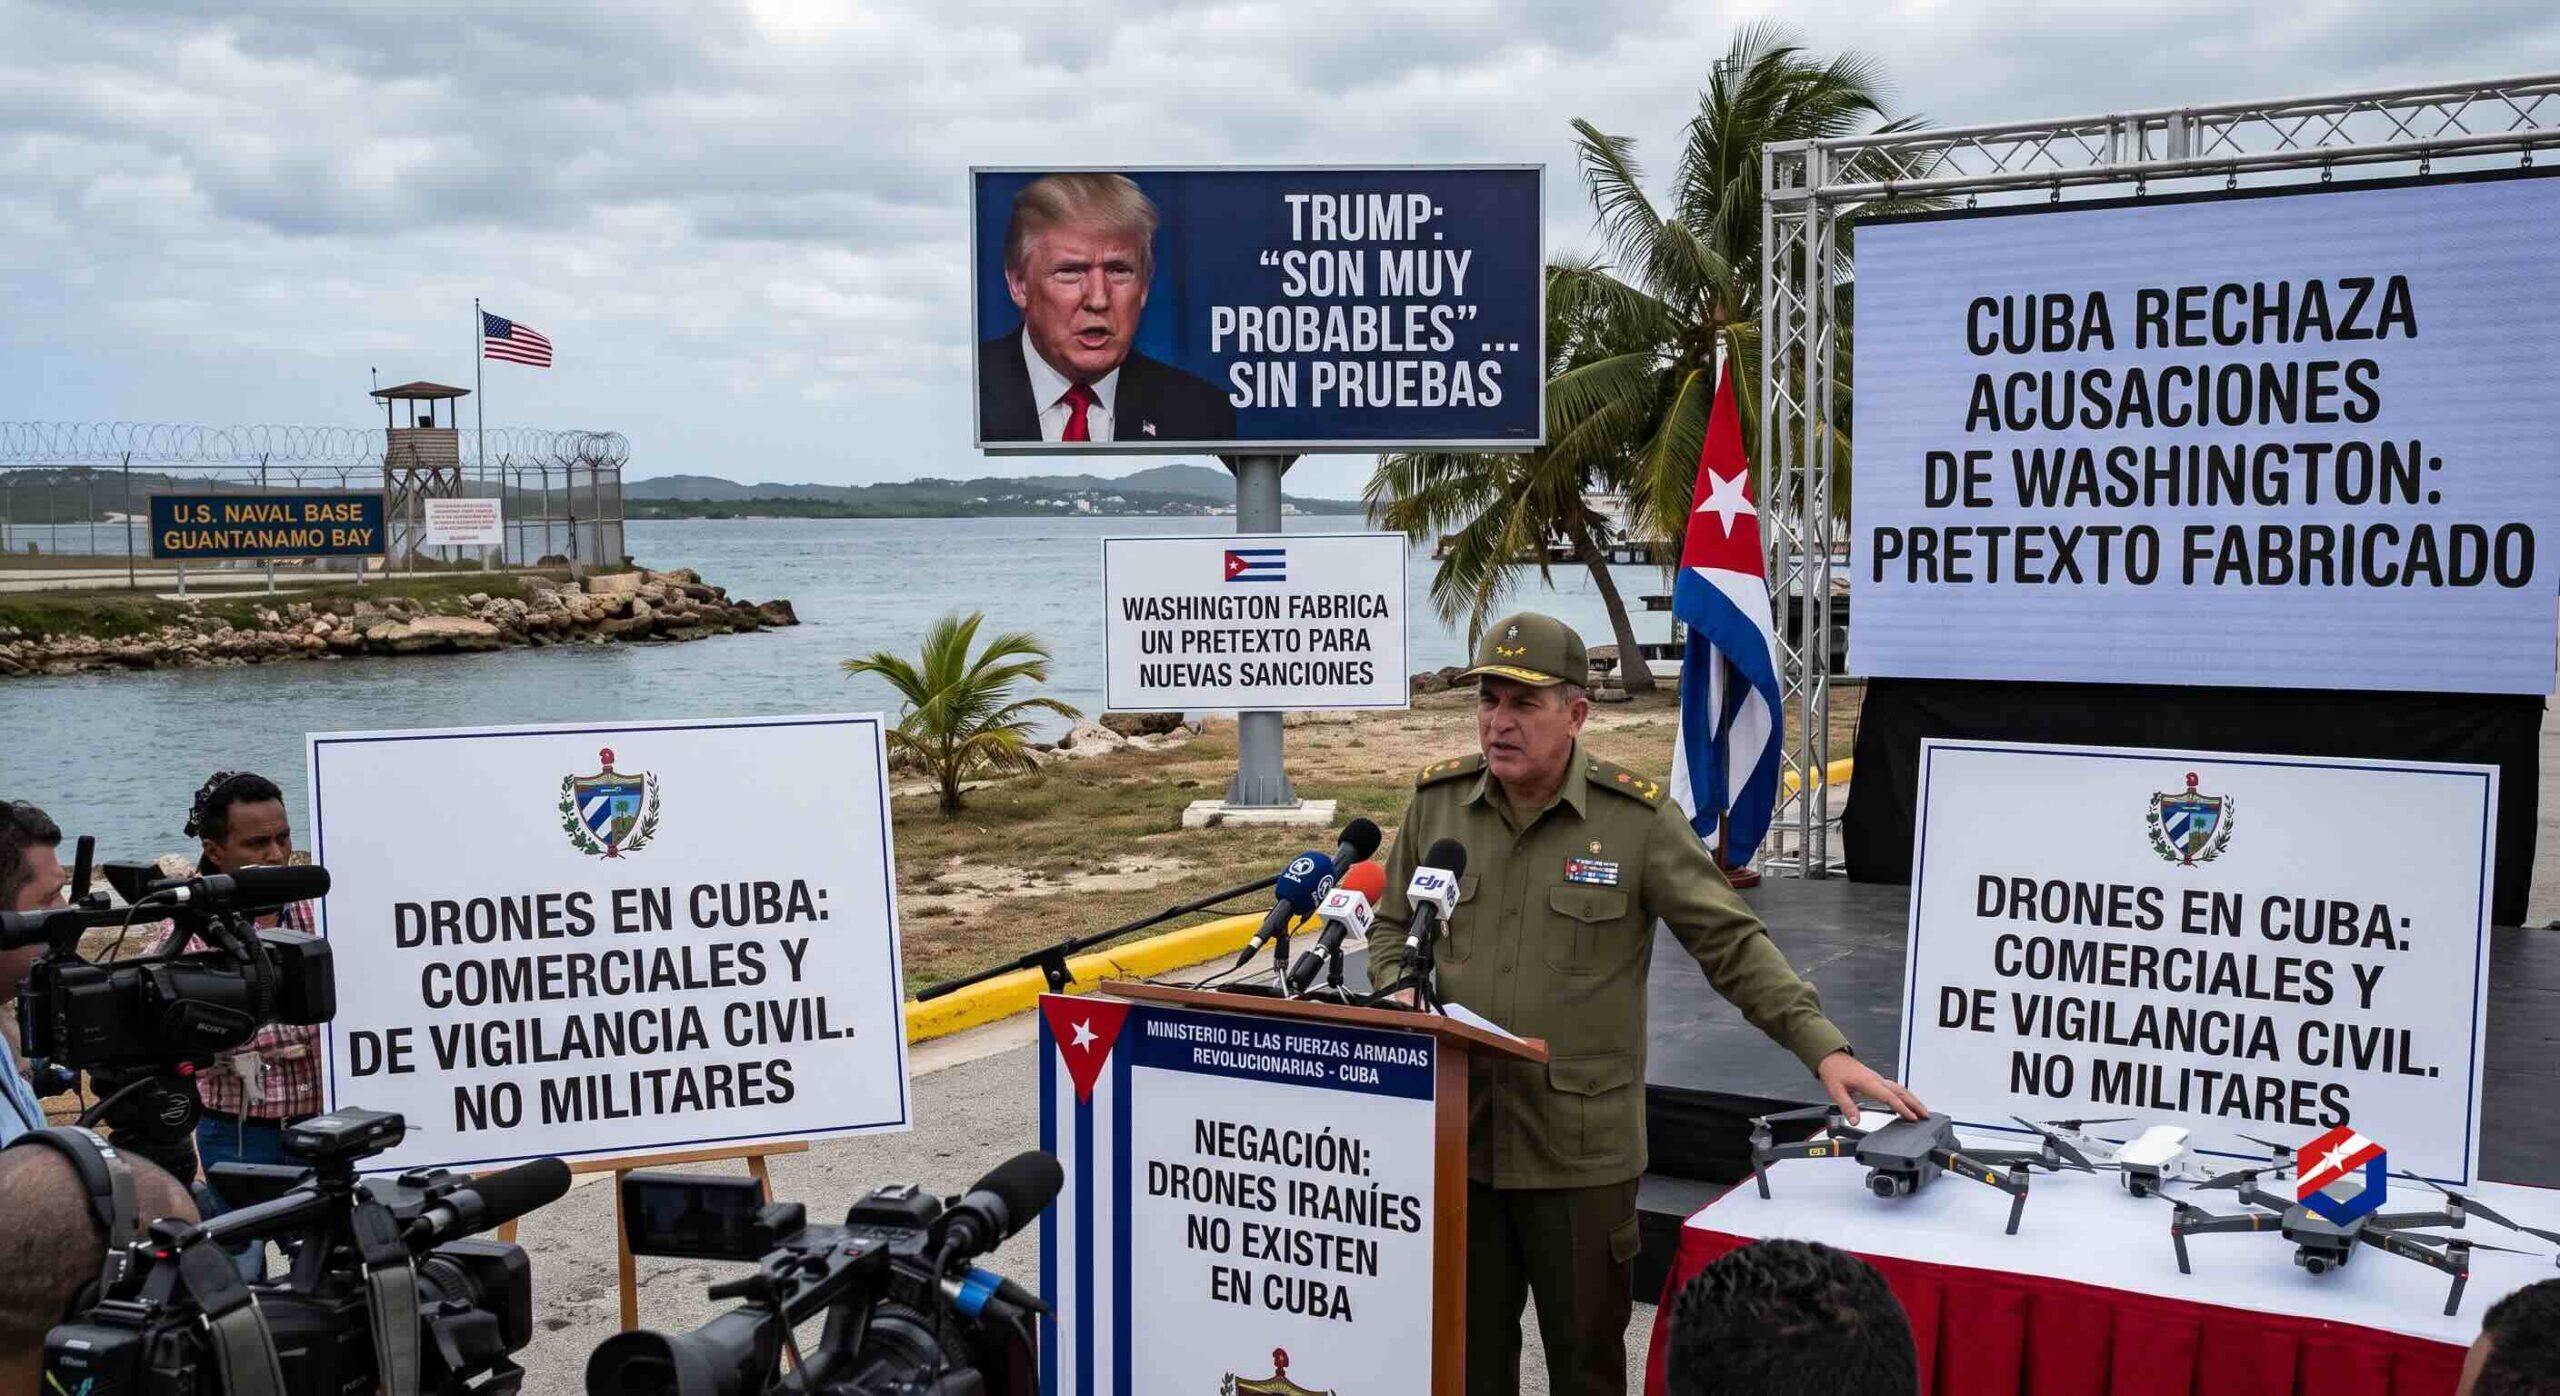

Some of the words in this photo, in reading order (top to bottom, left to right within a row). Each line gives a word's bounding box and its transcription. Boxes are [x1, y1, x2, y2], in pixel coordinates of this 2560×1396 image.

[1285, 194, 1442, 241] TRUMP:
[1261, 250, 1363, 296] “SON
[1380, 250, 1471, 296] MUY
[1967, 291, 2114, 355] CUBA
[2136, 275, 2417, 349] RECHAZA
[1230, 362, 1296, 407] SIN
[1313, 360, 1501, 407] PRUEBAS
[1966, 359, 2380, 432] ACUSACIONES
[1925, 451, 1993, 508] DE
[2012, 440, 2442, 507] WASHINGTON:
[165, 529, 323, 549] GUANTANAMO
[333, 529, 371, 546] BAY
[175, 505, 216, 522] U.S.
[226, 505, 296, 522] NAVAL
[305, 504, 362, 521] BASE
[1873, 525, 2159, 585] PRETEXTO
[2183, 523, 2534, 588] FABRICADO
[1123, 596, 1279, 620] WASHINGTON
[1289, 595, 1388, 618] FABRICA
[1142, 630, 1172, 654] UN
[1182, 629, 1300, 653] PRETEXTO
[1310, 628, 1371, 652] PARA
[1141, 663, 1232, 687] NUEVAS
[1240, 661, 1373, 686] SANCIONES
[395, 892, 595, 948] DRONES
[612, 887, 672, 933] EN
[690, 880, 828, 928] CUBA:
[1977, 875, 2163, 930] DRONES
[2182, 890, 2242, 937] EN
[2261, 896, 2410, 951] CUBA:
[422, 941, 766, 1008] COMERCIALES
[780, 938, 809, 981] Y
[1995, 934, 2333, 1005] COMERCIALES
[2352, 964, 2384, 1009] Y
[350, 1028, 415, 1076] DE
[429, 1006, 709, 1070] VIGILANCIA
[724, 997, 854, 1047] CIVIL.
[1148, 1021, 1226, 1044] MINISTERIO
[1232, 1030, 1249, 1046] DE
[1255, 1033, 1280, 1050] LAS
[1286, 1036, 1349, 1057] FUERZAS
[1354, 1044, 1427, 1066] ARMADAS
[1939, 986, 1996, 1032] DE
[2012, 993, 2280, 1061] VIGILANCIA
[2298, 1021, 2438, 1077] CIVIL.
[455, 1082, 522, 1132] NO
[541, 1059, 794, 1124] MILITARES
[1194, 1047, 1324, 1077] REVOLUCIONARIAS
[1340, 1065, 1379, 1084] CUBA
[2011, 1051, 2073, 1098] NO
[2091, 1059, 2350, 1128] MILITARES
[1196, 1119, 1369, 1176] NEGACIÓN:
[1149, 1161, 1276, 1212] DRONES
[1289, 1181, 1421, 1233] IRANÍES
[1188, 1214, 1230, 1253] NO
[1243, 1222, 1377, 1276] EXISTEN
[1212, 1265, 1251, 1305] EN
[1264, 1274, 1352, 1322] CUBA
